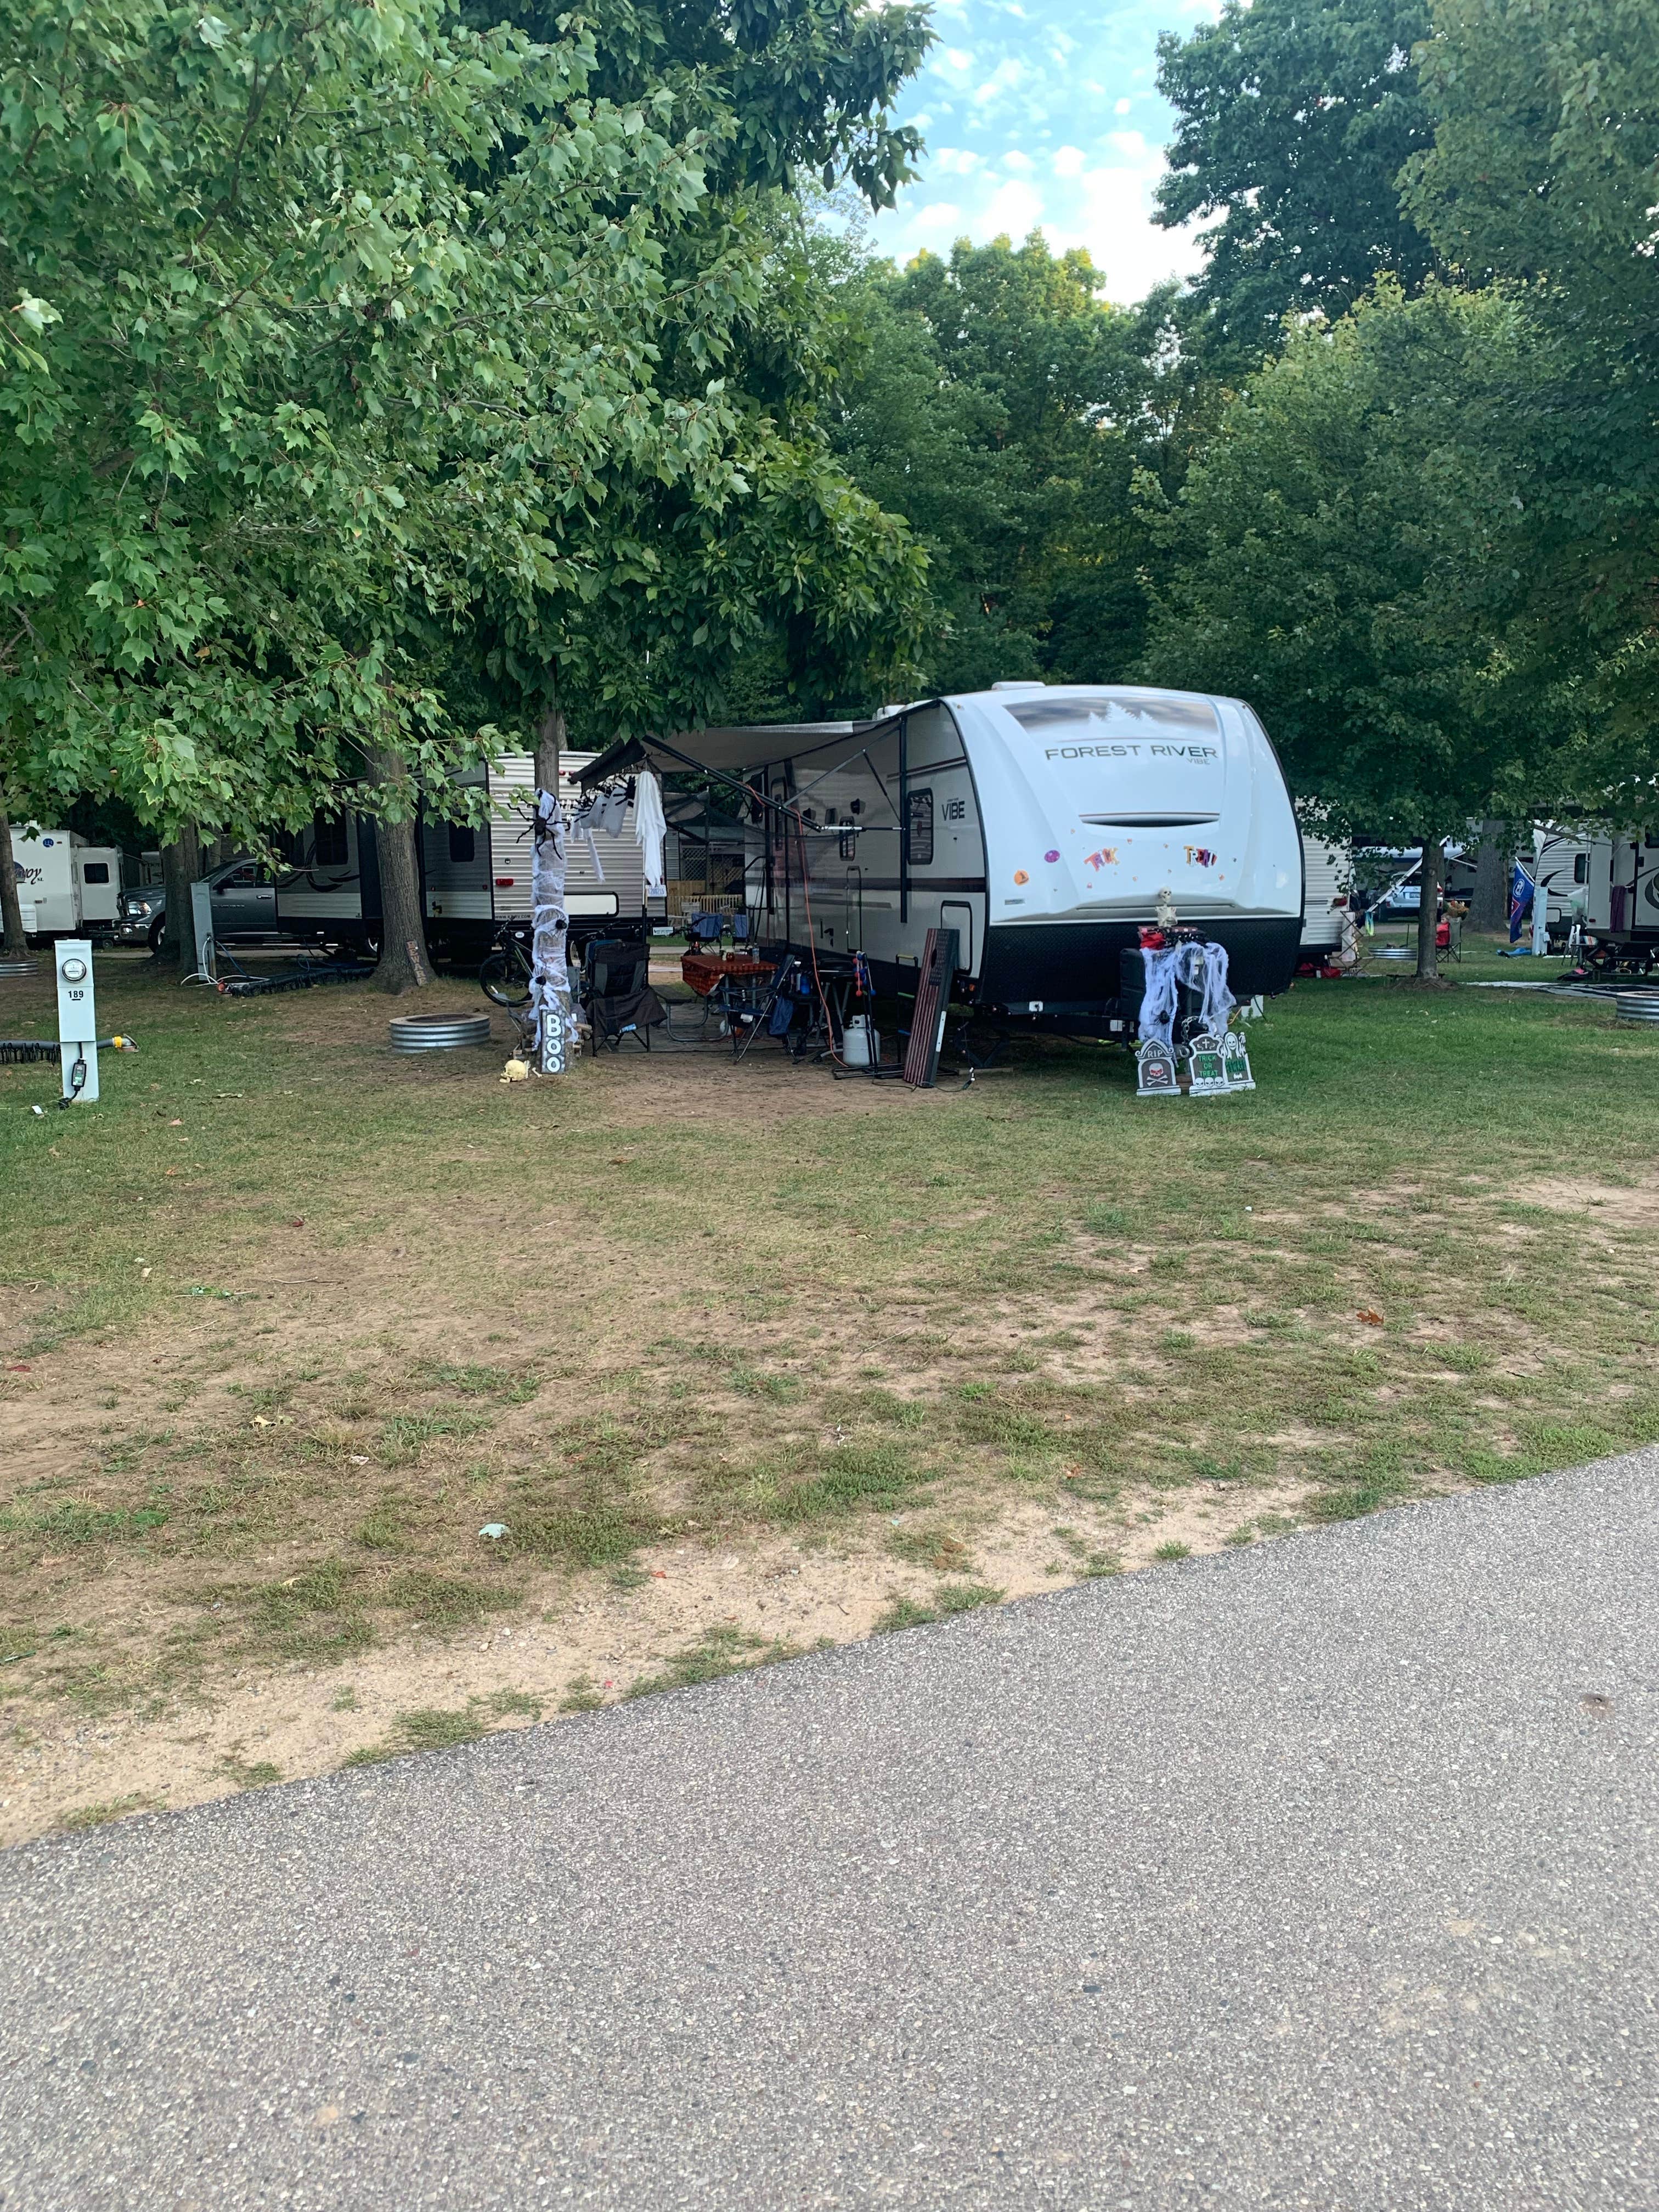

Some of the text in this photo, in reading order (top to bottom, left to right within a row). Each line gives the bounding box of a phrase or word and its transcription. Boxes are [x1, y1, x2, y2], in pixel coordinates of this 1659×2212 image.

[1044, 744, 1219, 761] FOREST RIVER
[941, 800, 965, 821] VIBE
[1084, 847, 1120, 872] TRICK
[68, 990, 84, 998] 189
[546, 1014, 562, 1073] BOO
